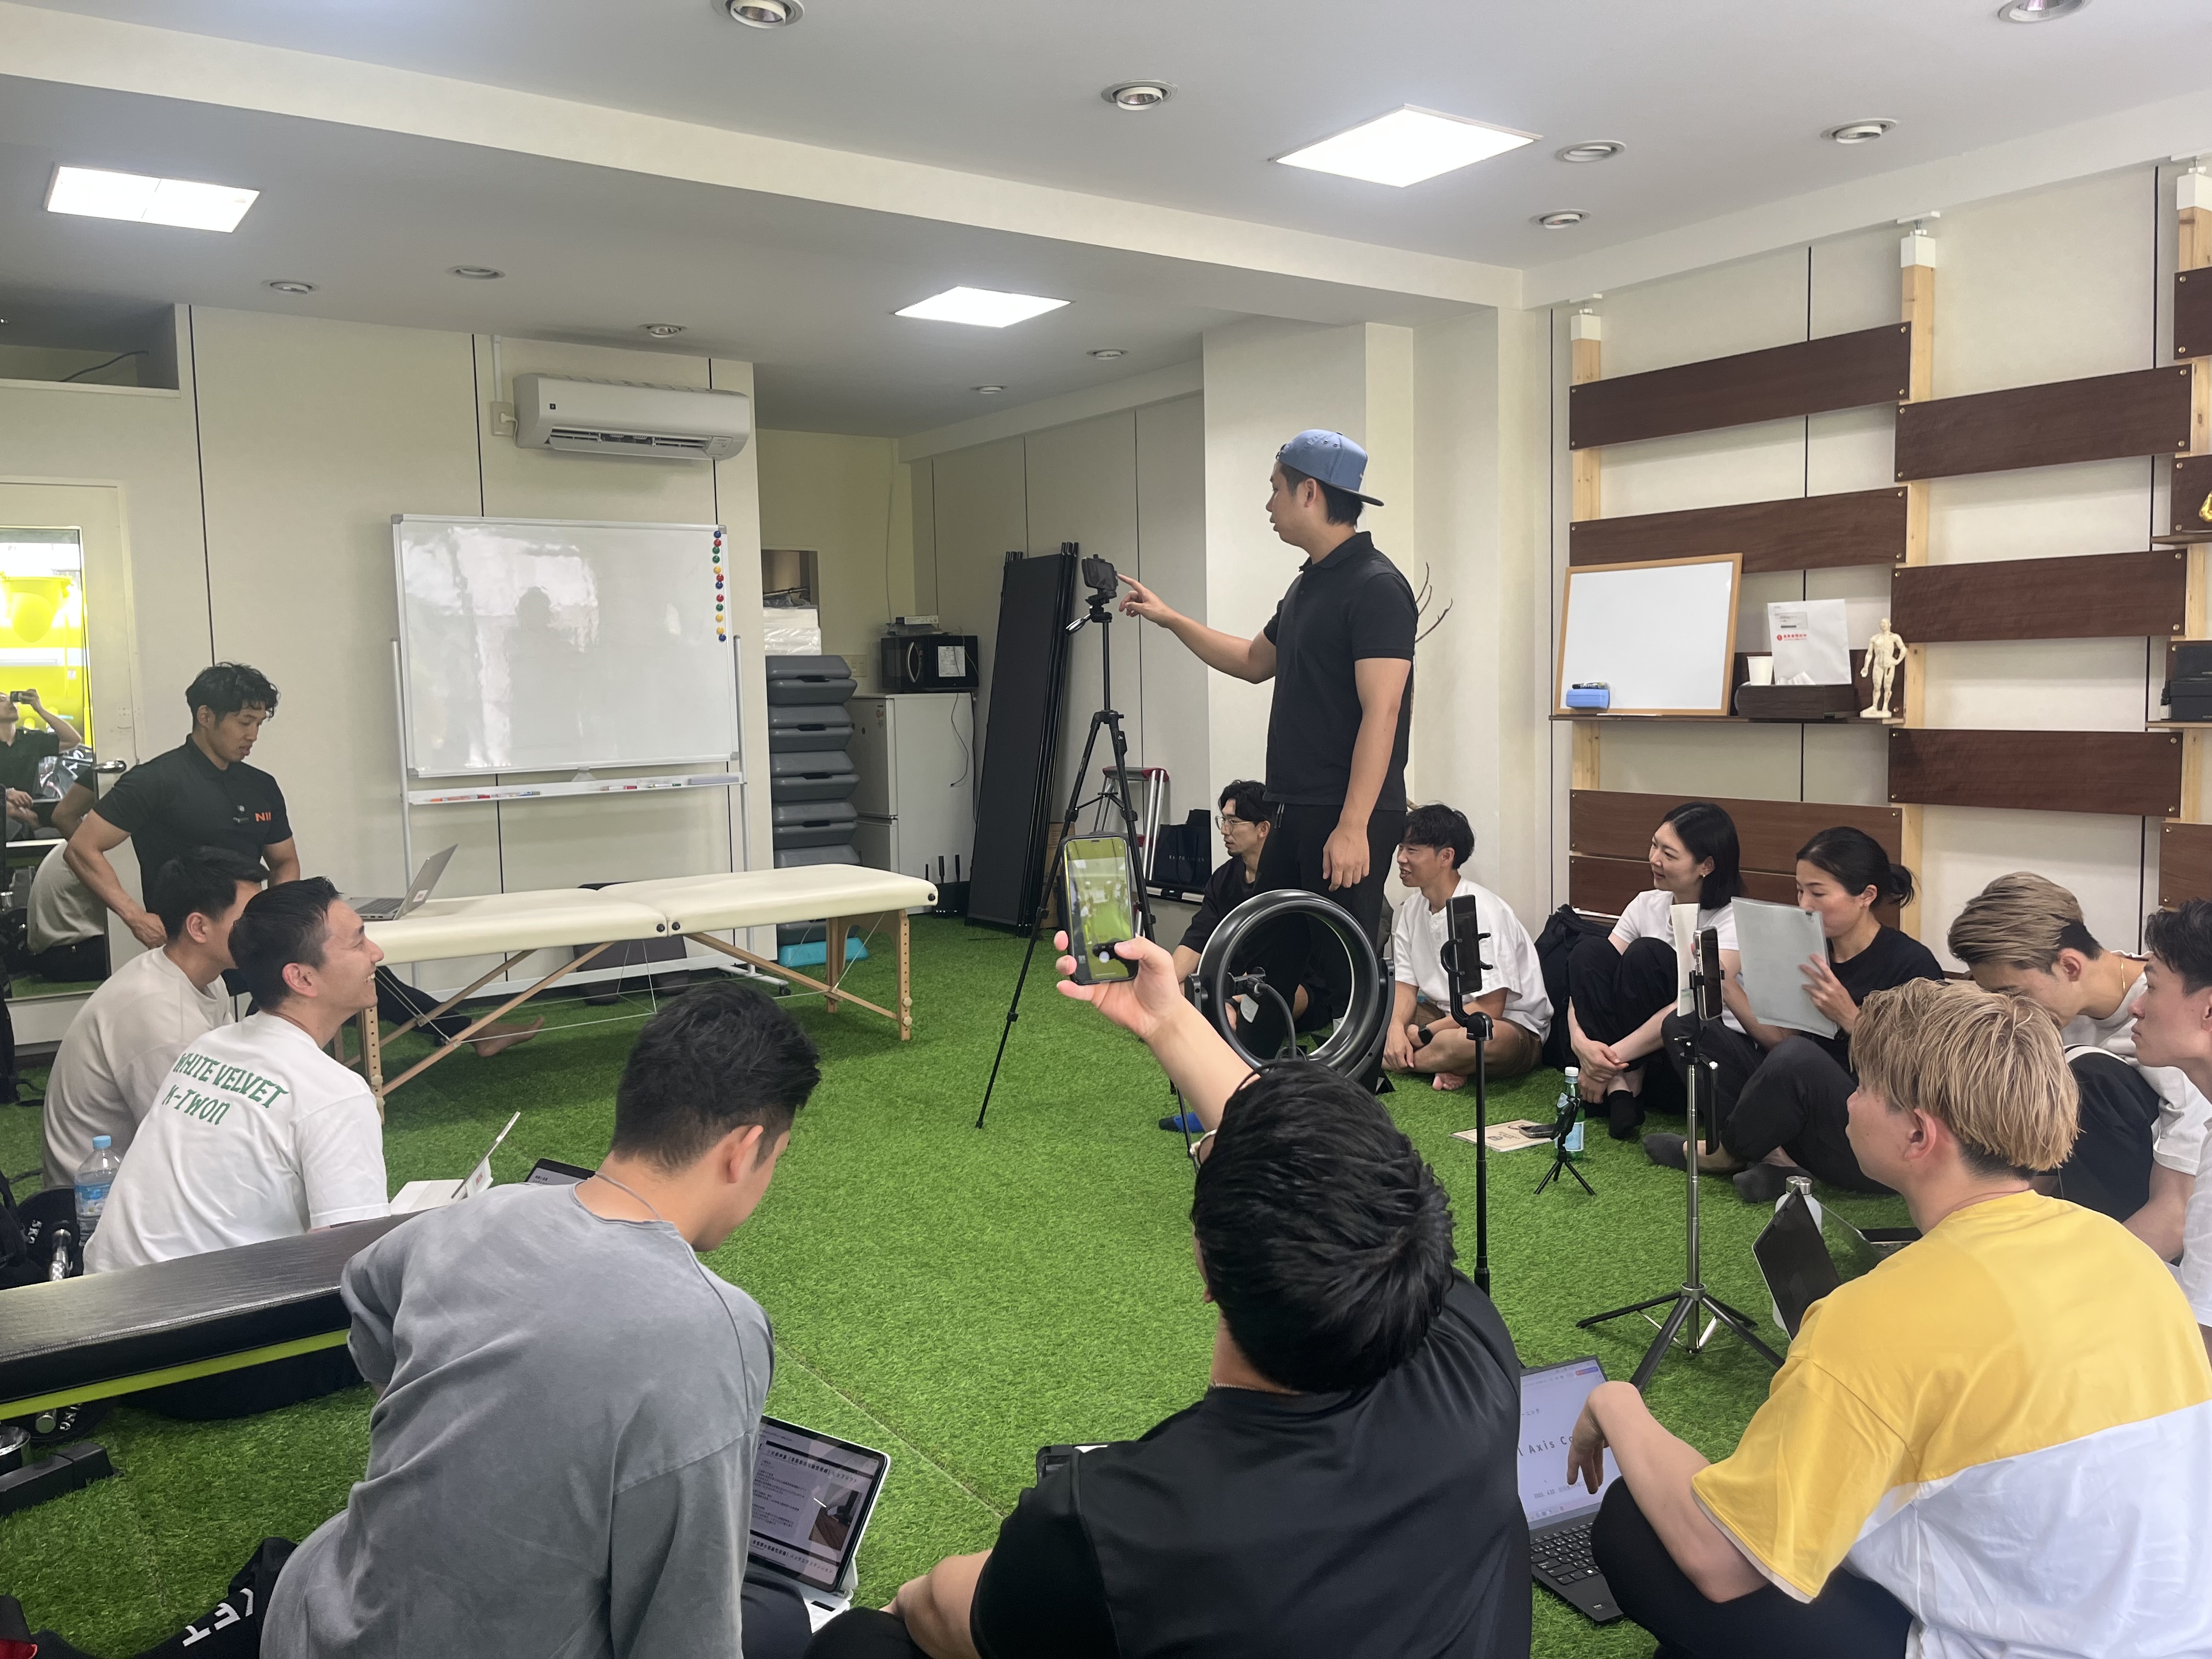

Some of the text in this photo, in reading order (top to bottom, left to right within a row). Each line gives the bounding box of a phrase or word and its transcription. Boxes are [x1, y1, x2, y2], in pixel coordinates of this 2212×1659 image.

[173, 1053, 289, 1108] WHITE VELVET
[1528, 1440, 1555, 1454] Axis
